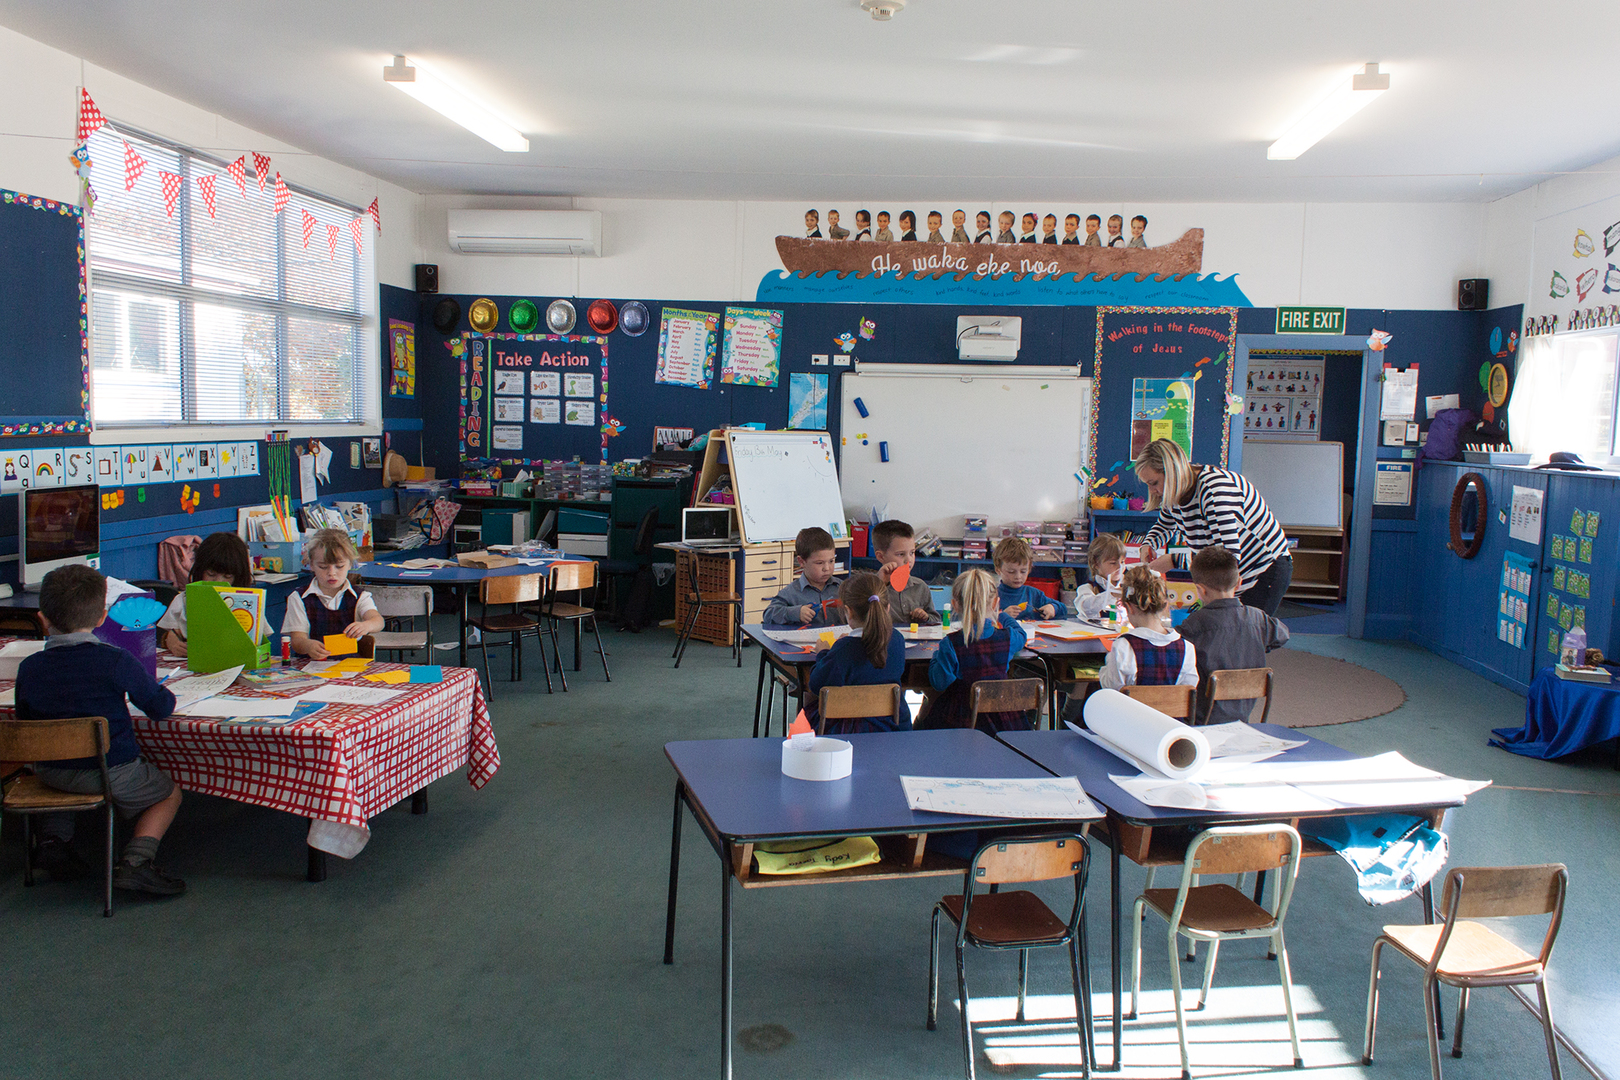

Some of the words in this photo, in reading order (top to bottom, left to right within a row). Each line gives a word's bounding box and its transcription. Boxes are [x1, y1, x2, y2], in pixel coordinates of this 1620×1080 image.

[872, 253, 902, 276] He
[912, 246, 969, 272] waka
[976, 253, 1012, 276] eke
[1020, 258, 1061, 276] noa
[804, 286, 825, 295] manage
[873, 288, 891, 296] respect
[895, 287, 914, 295] others
[1145, 290, 1164, 300] respect
[1118, 294, 1129, 303] say
[663, 309, 687, 317] Months
[727, 308, 744, 316] Days
[1281, 311, 1310, 328] FIRE
[1313, 311, 1341, 328] EXIT
[1108, 324, 1148, 342] Walking
[1154, 323, 1163, 332] in
[1168, 322, 1182, 332] the
[1188, 323, 1229, 343] Footsteps
[1133, 344, 1143, 353] of
[496, 352, 532, 366] Take
[540, 351, 589, 366] Action
[467, 340, 484, 447] READING
[113, 451, 118, 463] T
[139, 450, 146, 462] U
[231, 446, 236, 457] Y
[767, 446, 782, 461] May
[19, 455, 29, 468] Q
[56, 454, 62, 466] R
[58, 476, 62, 484] r
[115, 470, 118, 480] t
[140, 471, 145, 479] u
[22, 478, 29, 488] q
[824, 853, 850, 864] Kody
